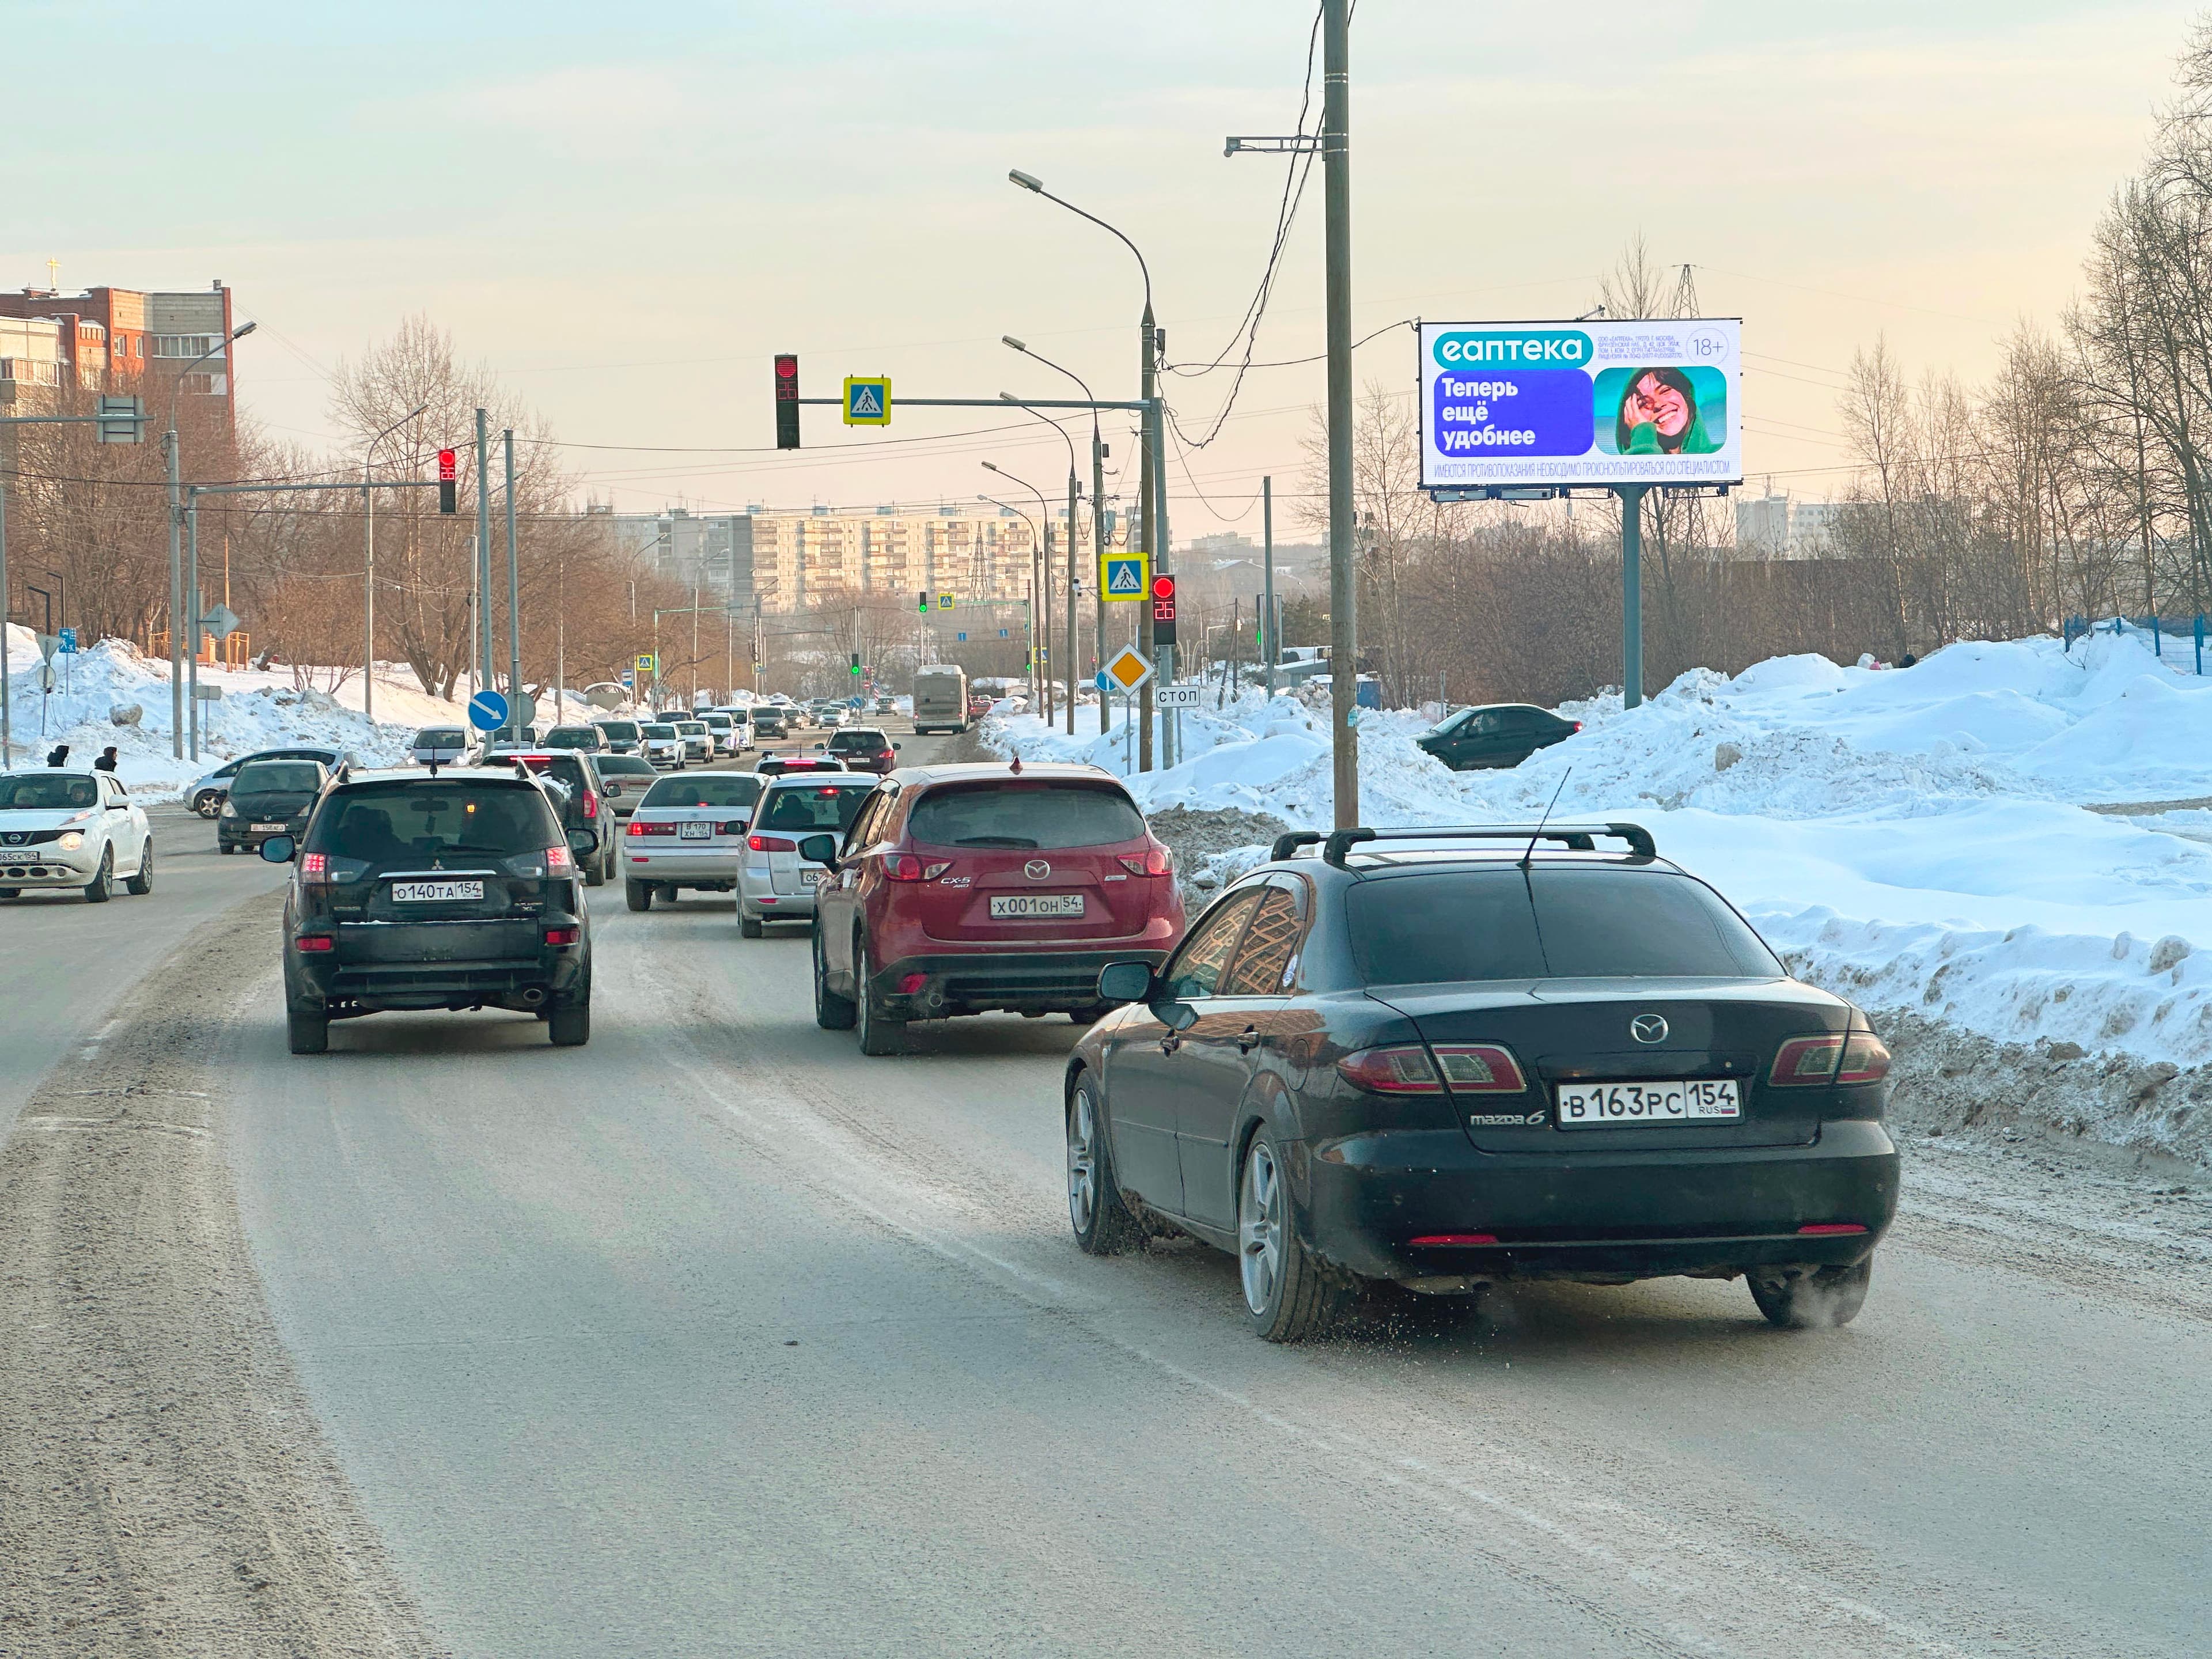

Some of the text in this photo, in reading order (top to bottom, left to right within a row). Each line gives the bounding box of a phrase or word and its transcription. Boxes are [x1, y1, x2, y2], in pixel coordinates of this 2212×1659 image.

[1442, 339, 1582, 362] еаптека
[1694, 339, 1724, 355] 18+
[1442, 377, 1518, 401] Теперь
[1442, 400, 1488, 425] ещё
[1442, 424, 1536, 450] удобнее
[1155, 601, 1174, 619] 26
[1159, 691, 1196, 702] СТОП
[457, 882, 479, 893] 154
[1063, 896, 1078, 908] 54
[1688, 1084, 1731, 1105] 154
[1699, 1106, 1719, 1114] RUS
